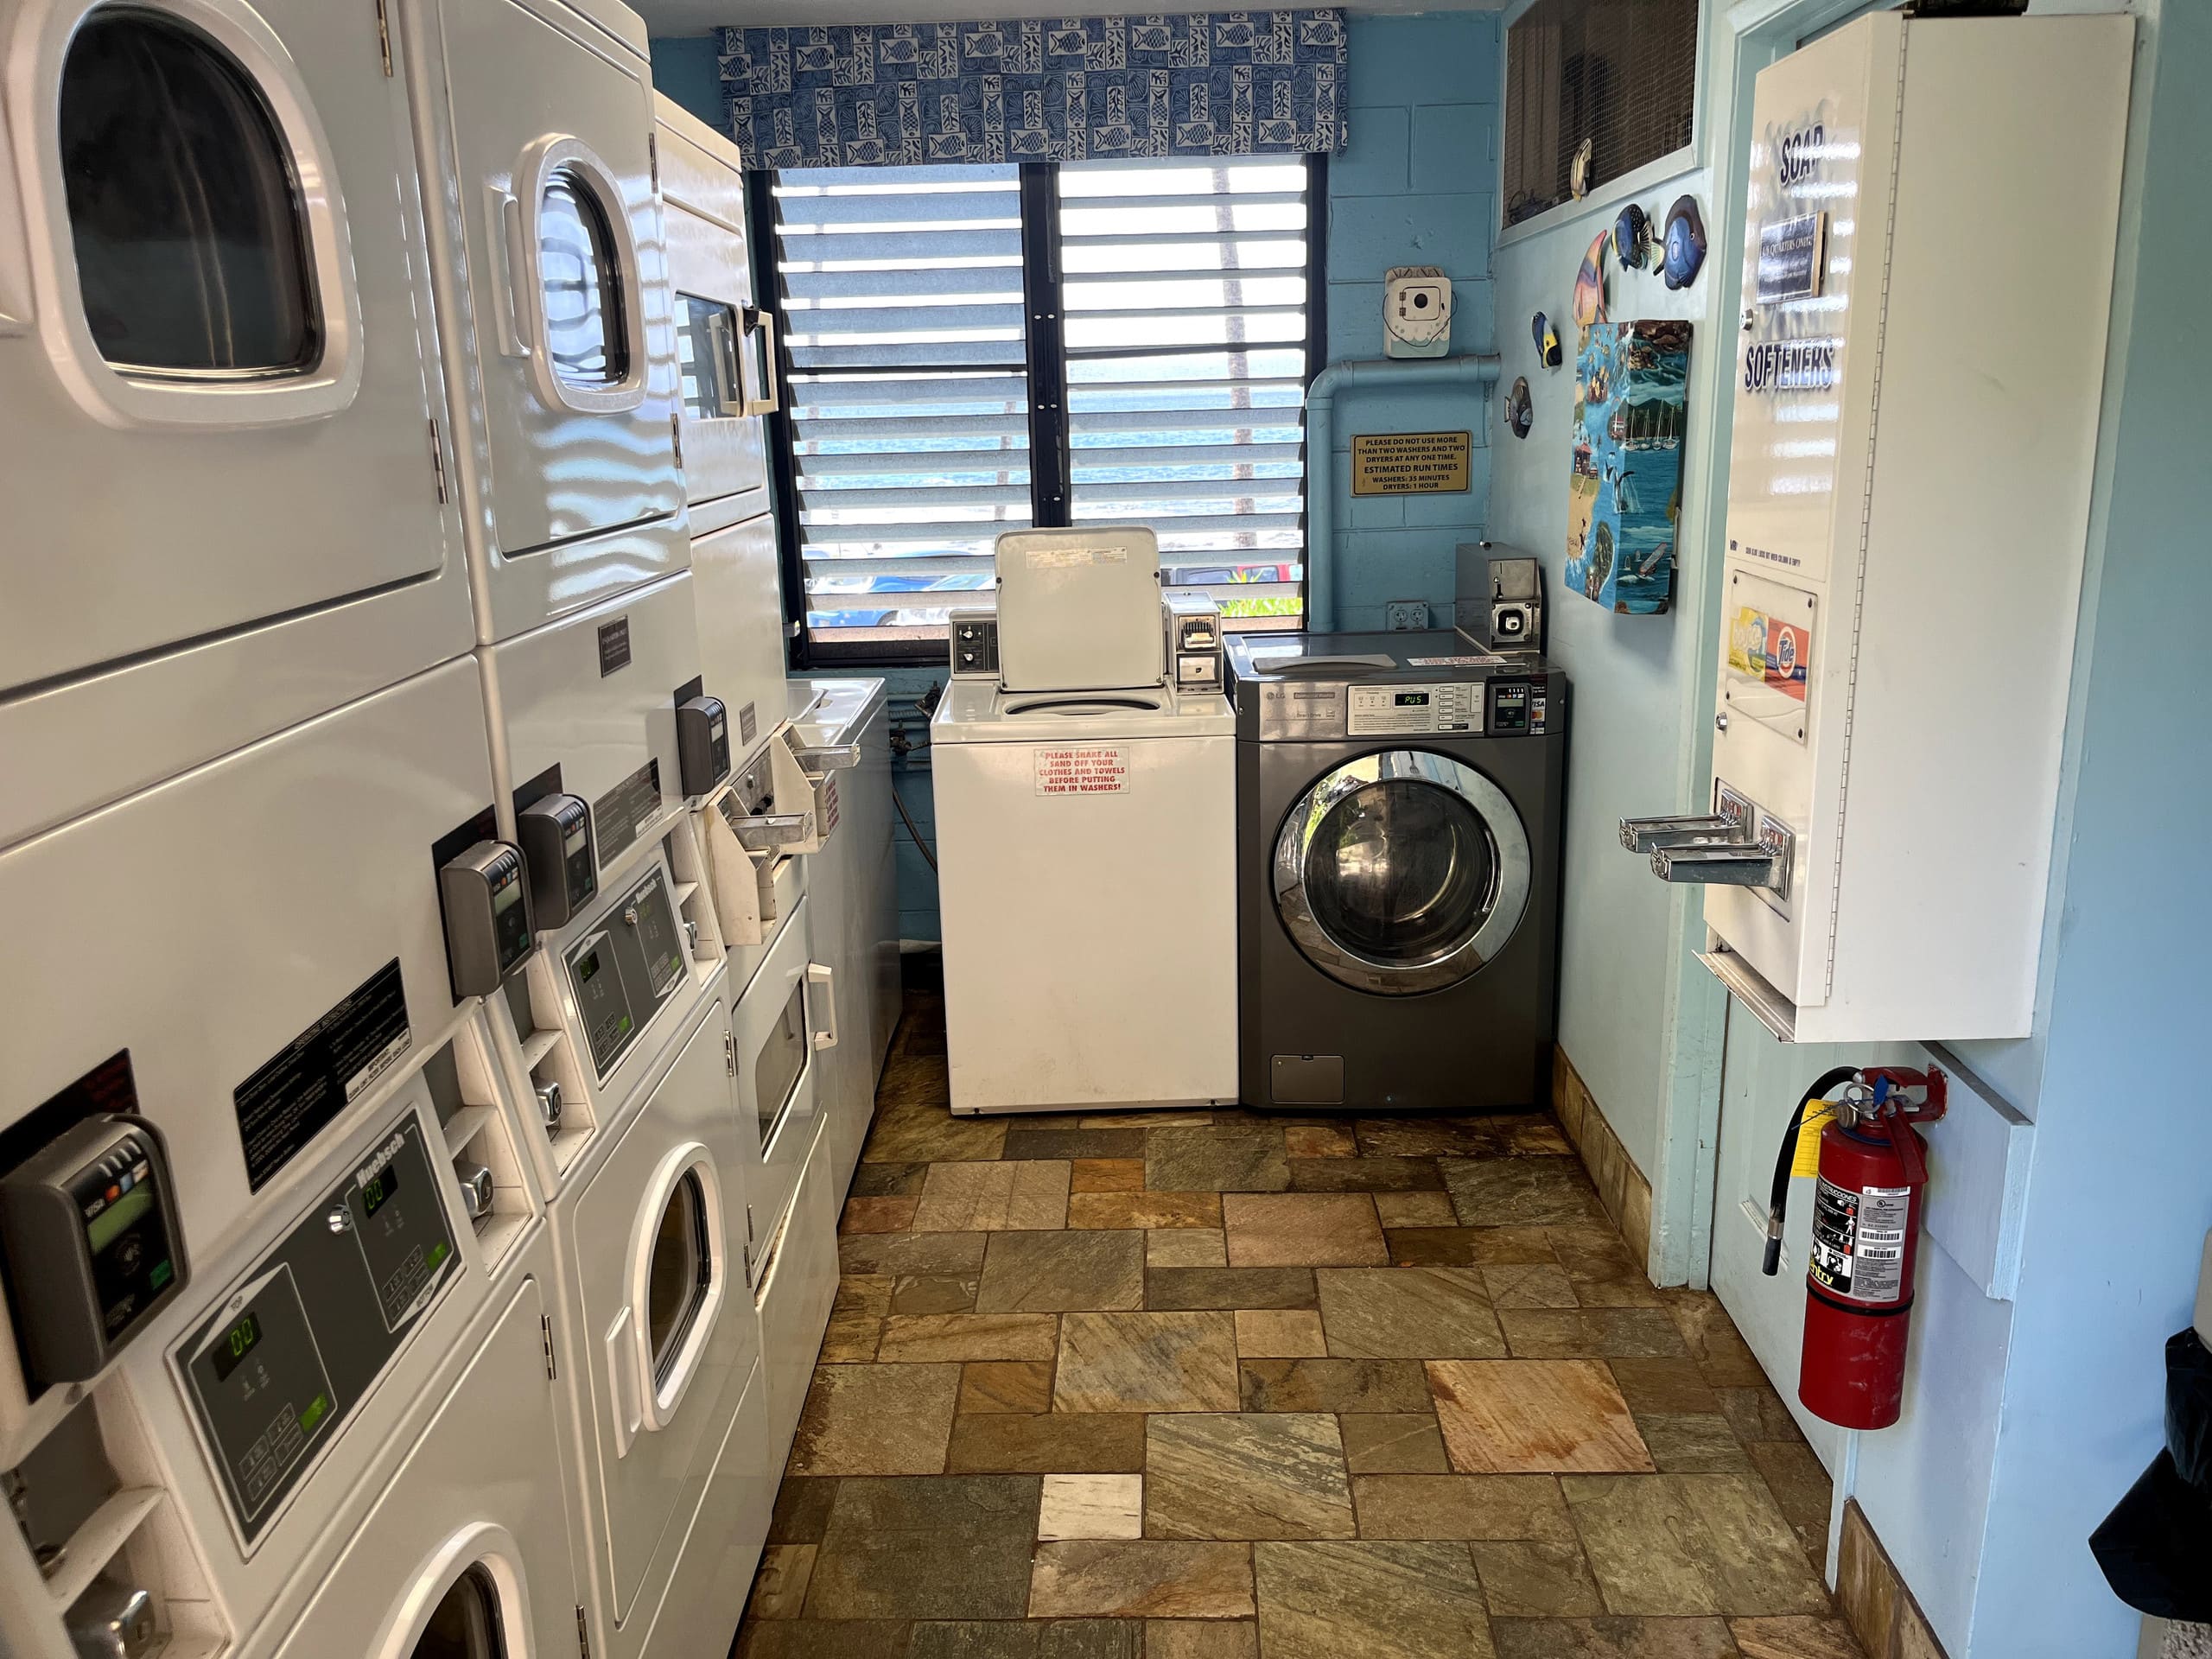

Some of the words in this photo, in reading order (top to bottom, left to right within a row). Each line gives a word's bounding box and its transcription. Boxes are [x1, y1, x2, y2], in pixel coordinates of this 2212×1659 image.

[1780, 124, 1826, 185] SOAP
[1745, 339, 1834, 391] SOFTENERS
[1396, 445, 1430, 454] WASHERS
[1364, 465, 1411, 474] ESTIMATED
[1779, 639, 1795, 664] Tide
[356, 1133, 405, 1189] Huebsch
[231, 1295, 244, 1312] TOP
[231, 1318, 253, 1356] 00
